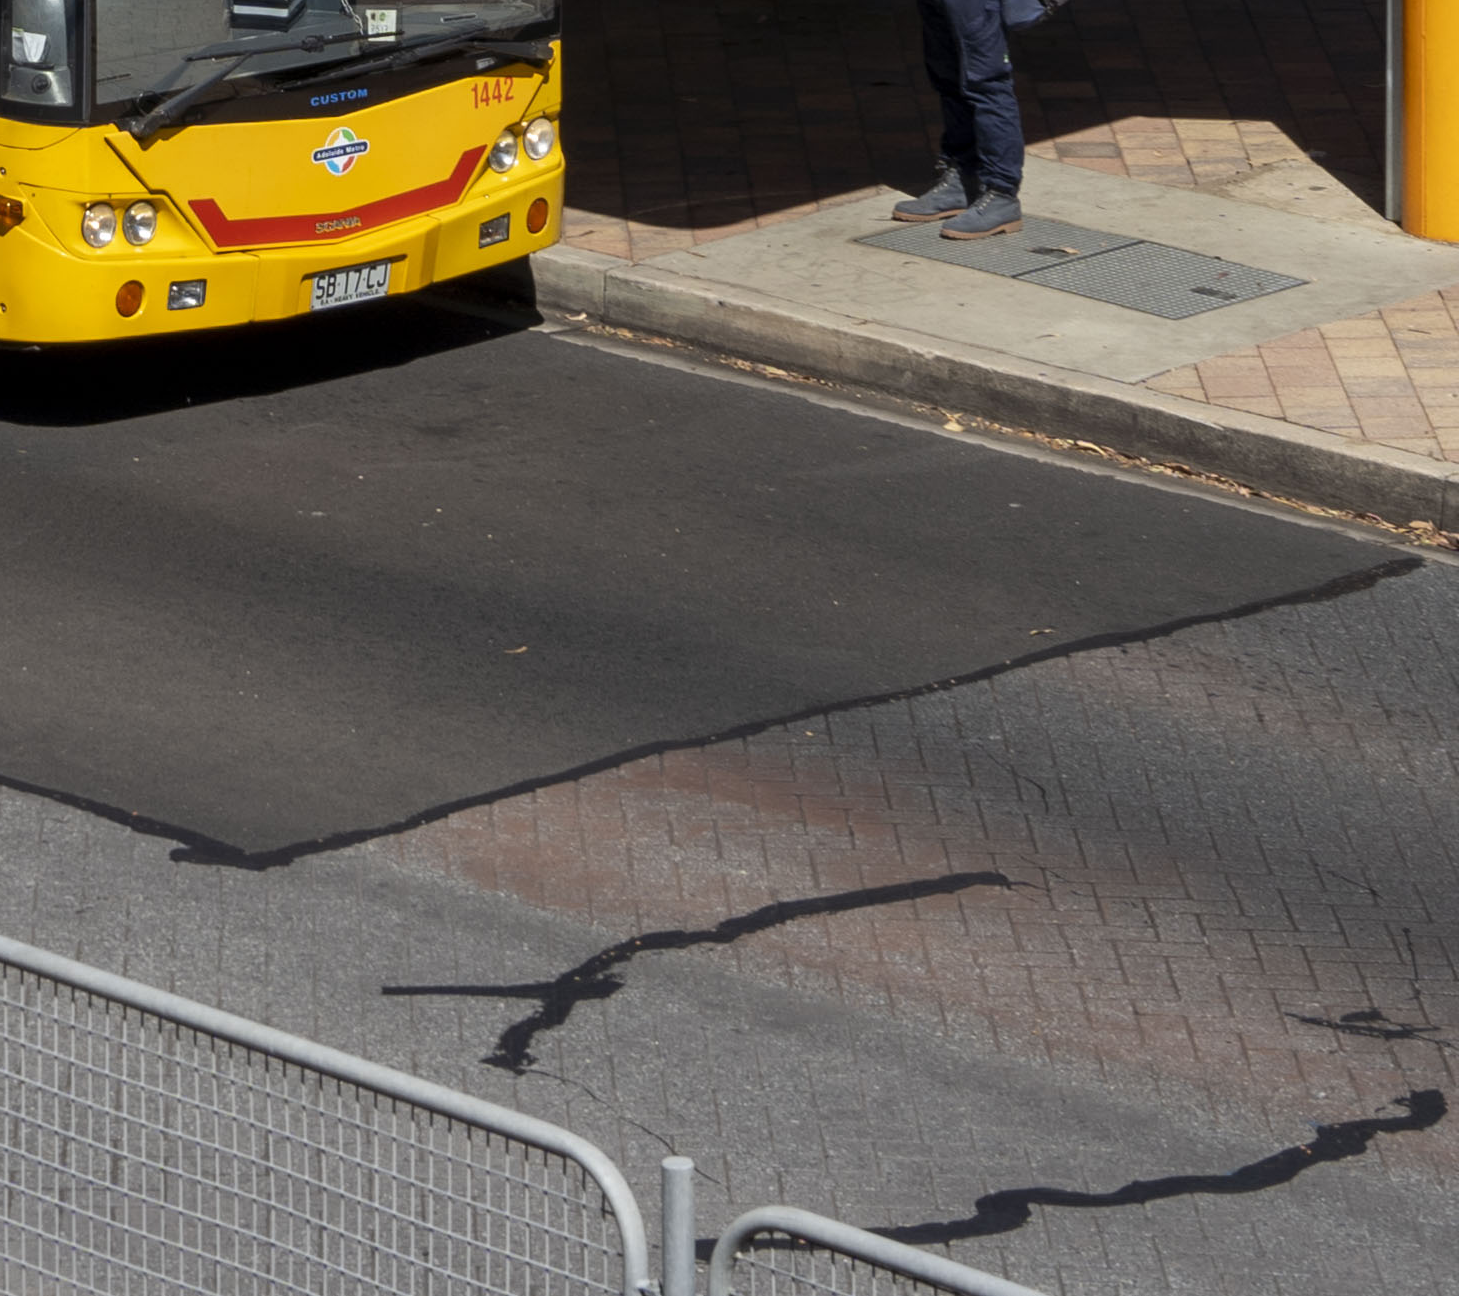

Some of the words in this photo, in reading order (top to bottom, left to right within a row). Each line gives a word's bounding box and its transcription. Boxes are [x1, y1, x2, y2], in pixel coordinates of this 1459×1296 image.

[310, 88, 369, 107] CUSTOM
[471, 76, 515, 109] 1442
[316, 148, 345, 159] Adelaide
[315, 216, 362, 234] SCANIA
